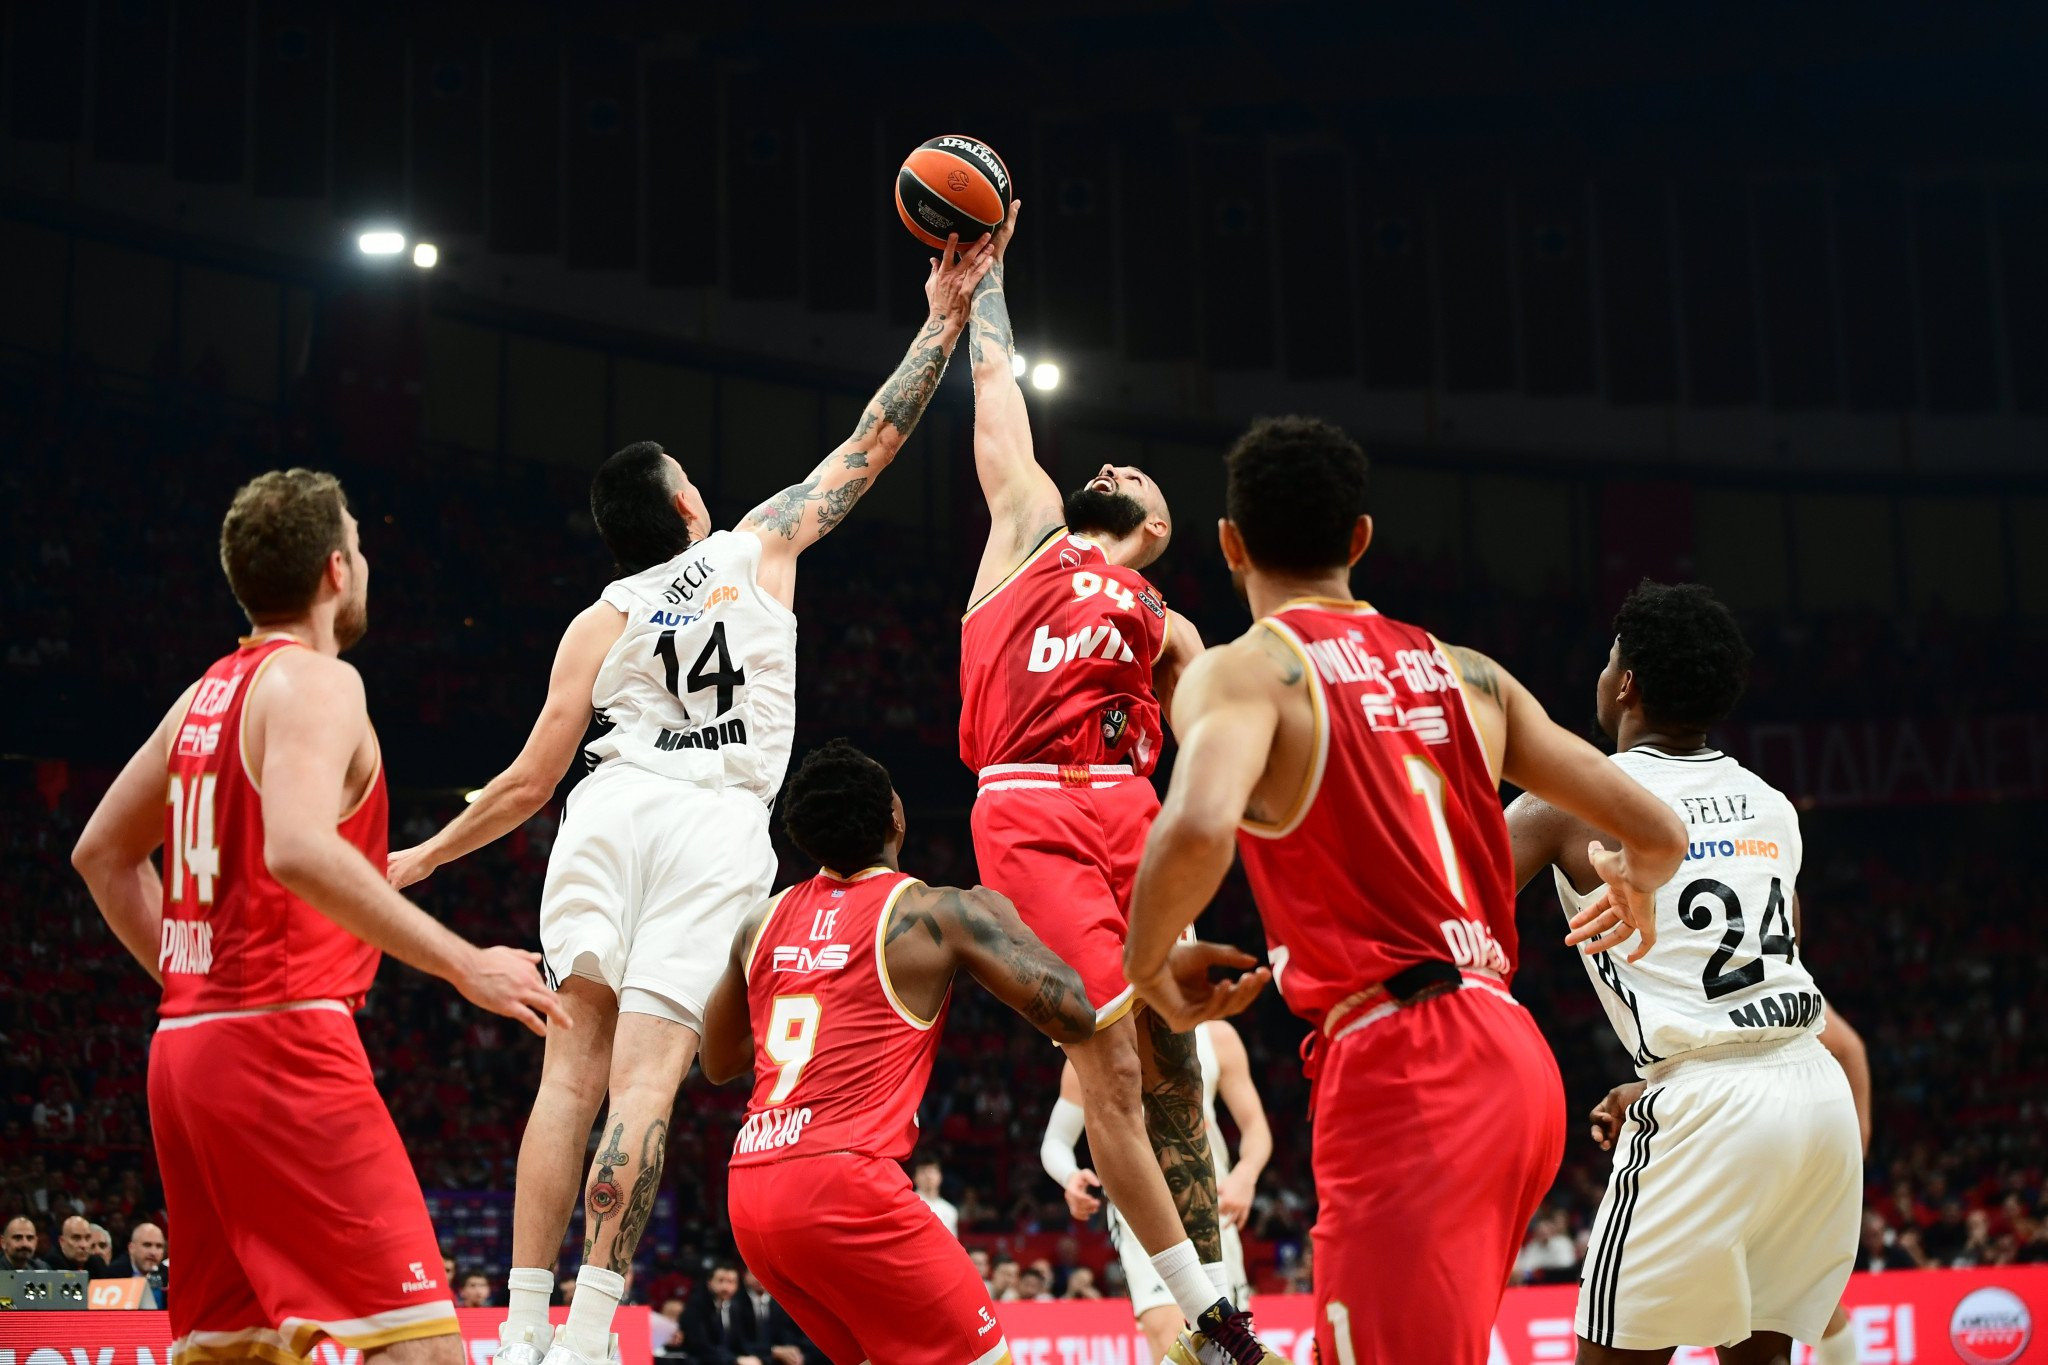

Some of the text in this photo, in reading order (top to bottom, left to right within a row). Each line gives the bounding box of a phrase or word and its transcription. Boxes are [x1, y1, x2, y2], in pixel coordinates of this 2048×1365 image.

[938, 137, 1008, 192] SPALDING
[649, 585, 739, 627] AUTOHERO
[661, 556, 716, 606] DECK
[1072, 571, 1136, 612] 94
[1138, 591, 1164, 618] oneteam
[653, 621, 746, 720] 14
[1402, 754, 1469, 913] 1
[1680, 793, 1756, 825] FELIZ
[166, 772, 220, 904] 14
[772, 944, 850, 973] FMS
[1677, 876, 1797, 1001] 24
[764, 993, 823, 1105] 9
